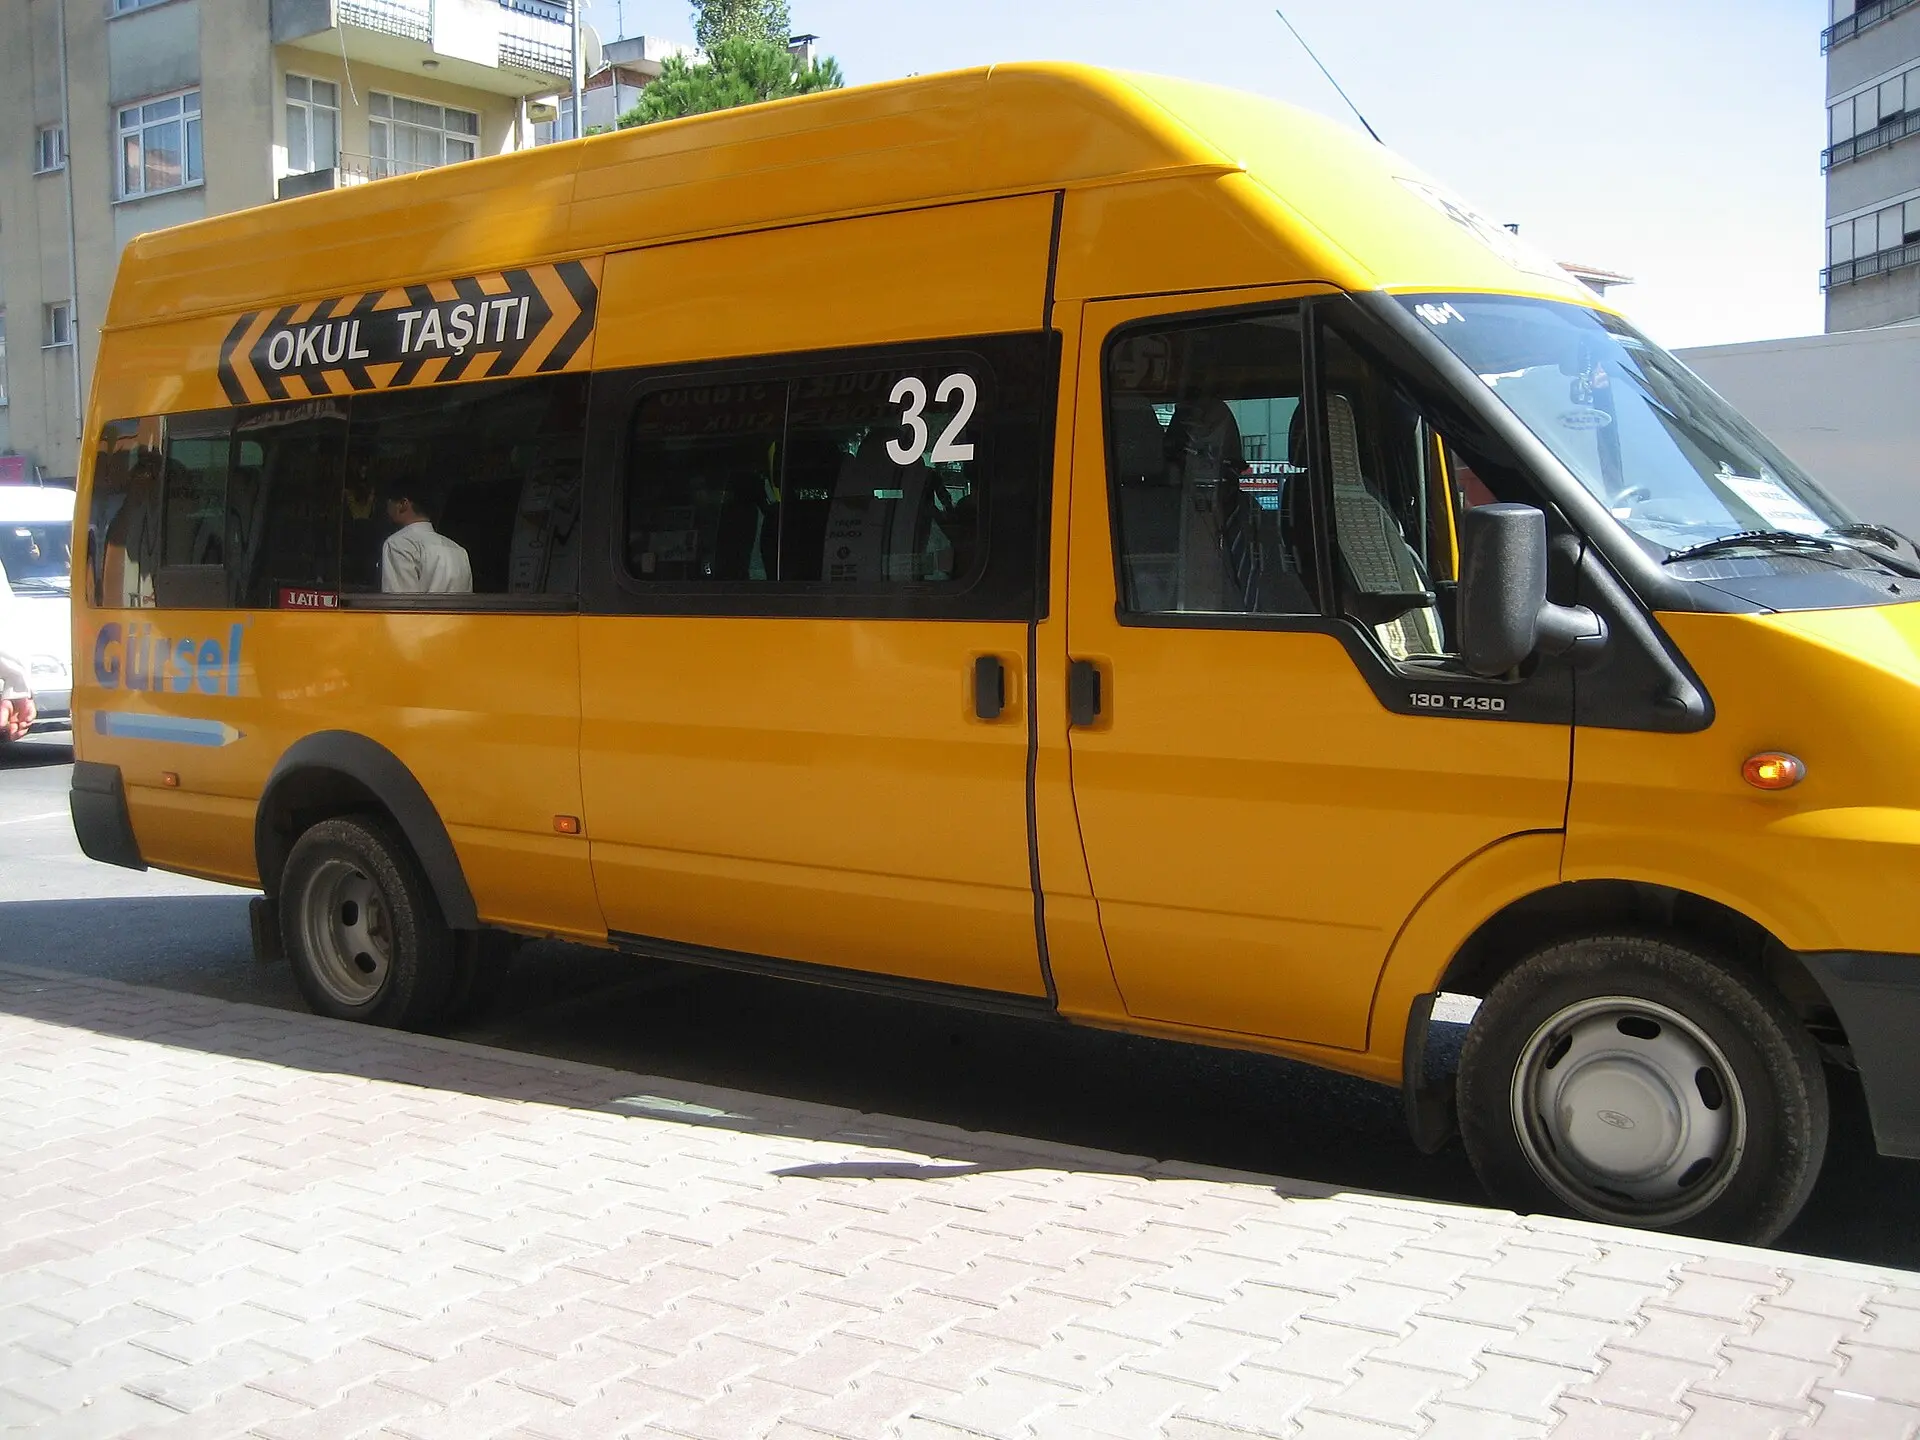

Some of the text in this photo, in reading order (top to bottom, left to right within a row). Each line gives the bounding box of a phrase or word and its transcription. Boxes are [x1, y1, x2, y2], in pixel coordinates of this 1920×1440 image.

[267, 296, 530, 371] OKUL TAŞITI
[885, 373, 978, 467] 32
[94, 621, 244, 697] Gürsel
[1408, 692, 1506, 712] 130 T430
